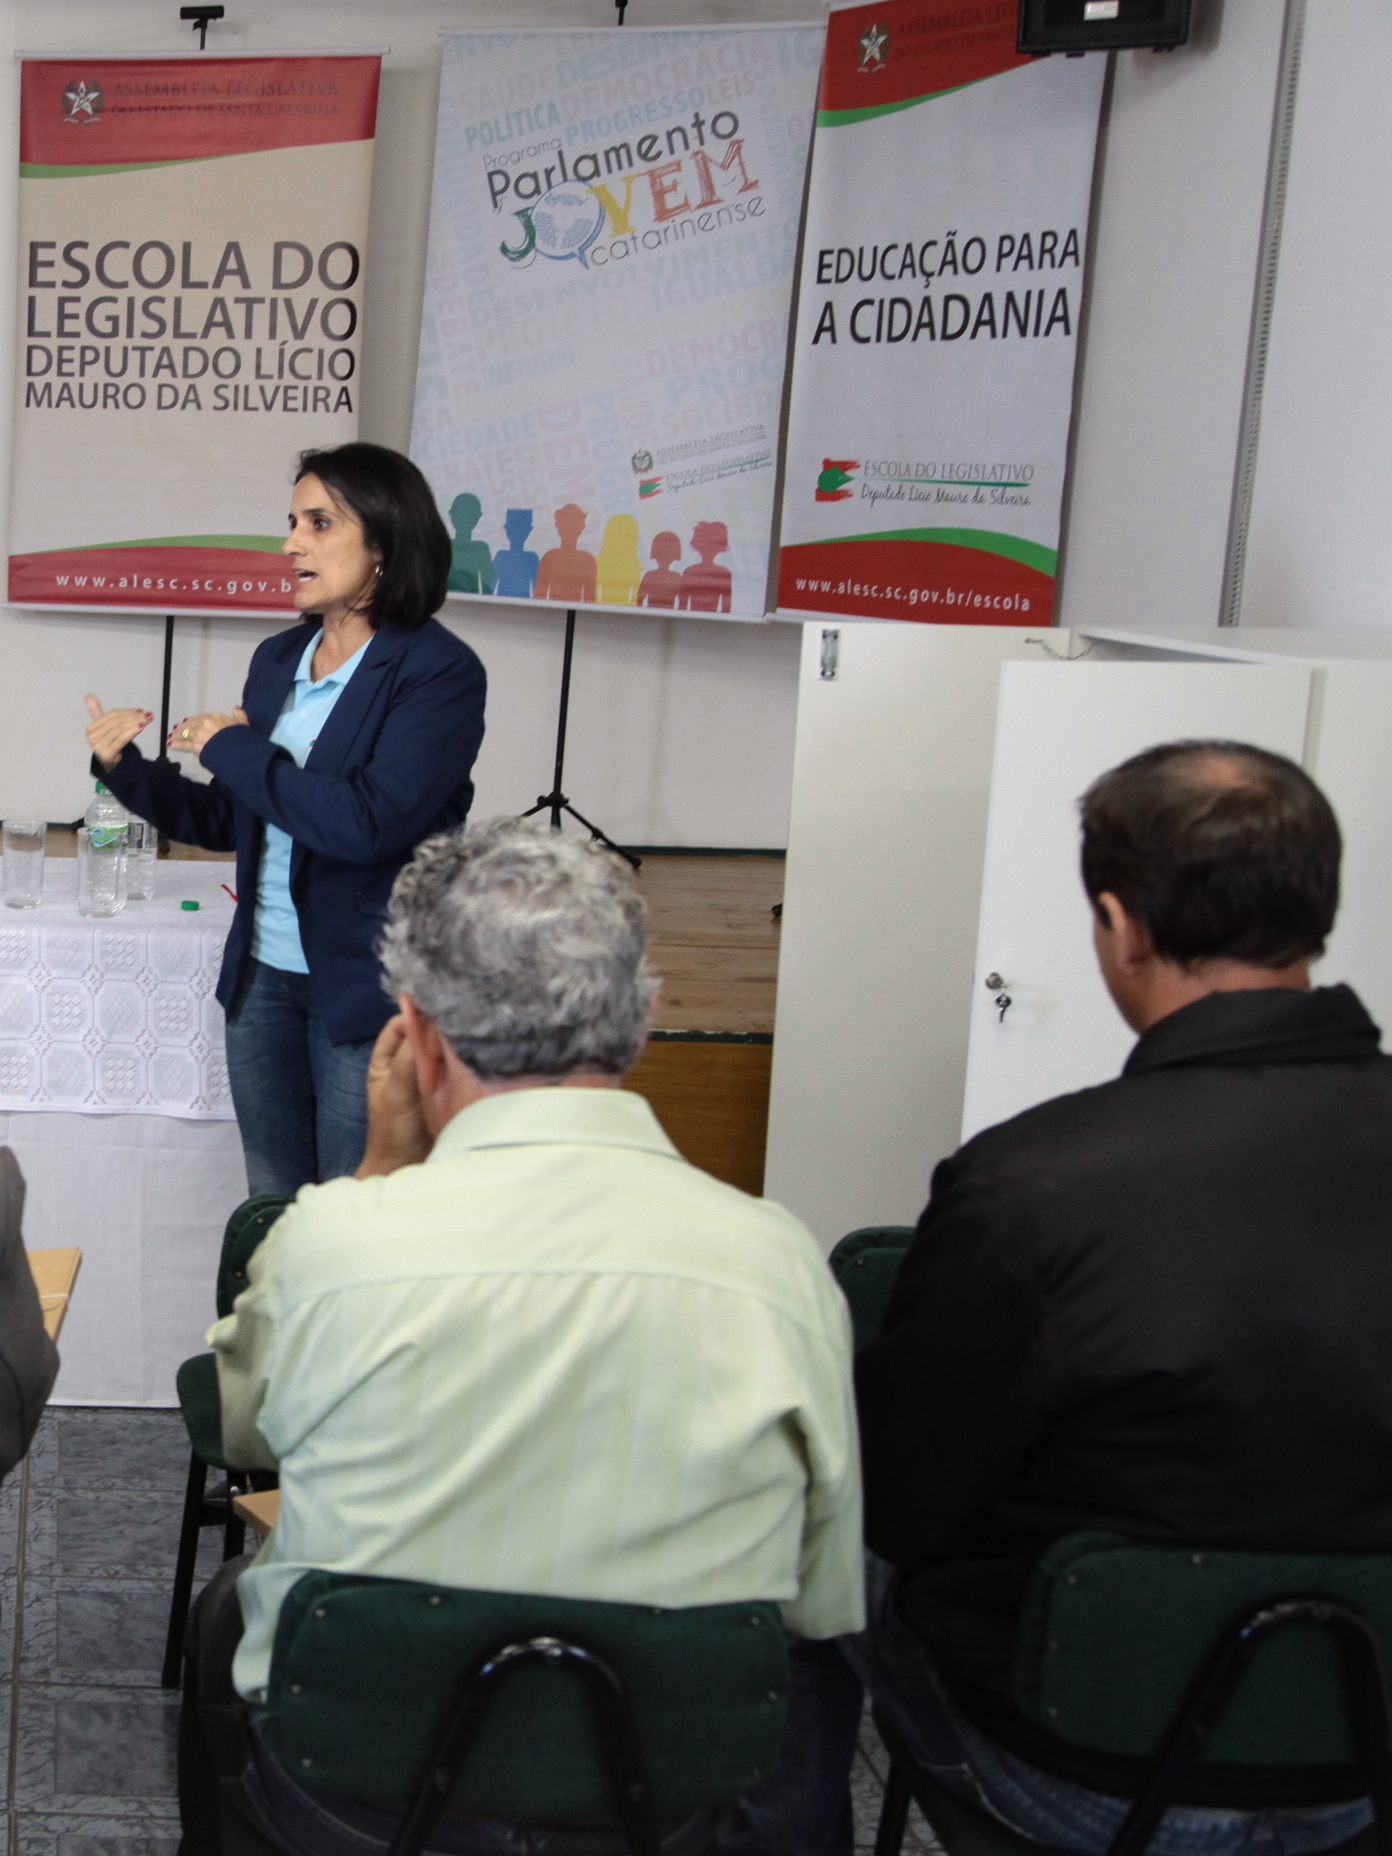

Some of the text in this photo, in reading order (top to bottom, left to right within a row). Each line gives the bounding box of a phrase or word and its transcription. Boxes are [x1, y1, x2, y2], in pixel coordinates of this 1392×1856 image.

[464, 70, 756, 151] POLÍTICA PROGRESSO LEIS
[482, 137, 562, 171] Programa
[486, 110, 740, 213] Parlamento
[499, 138, 760, 270] JOVEM
[590, 195, 766, 267] catarinense
[27, 241, 361, 292] ESCOLA DO
[816, 228, 1081, 289] EDUCAÇÃO PARA
[26, 295, 359, 342] LEGISLATIVO
[811, 300, 838, 347] A
[848, 287, 1072, 345] CIDADANIA
[25, 340, 356, 381] DEPUTADO LÍCIO
[24, 382, 353, 414] MAURO DA SILVEIRA
[863, 460, 1035, 482] ESCOLA DO LEGISLATIVO
[860, 482, 906, 509] Deputado
[55, 574, 293, 595] www.alesc.sc.gov.b
[795, 578, 1031, 612] www.alesc.sc.gov.br/escola
